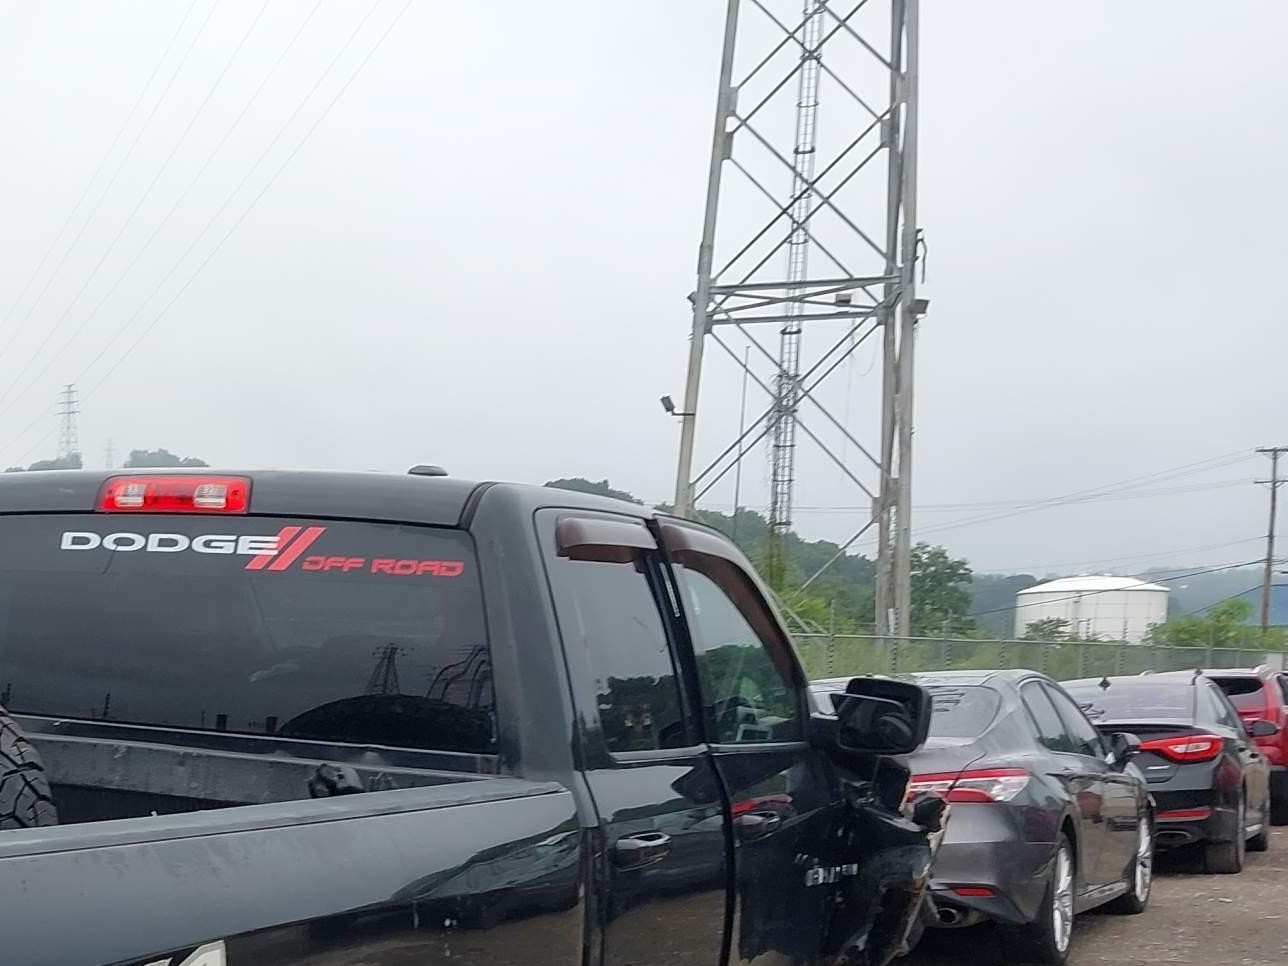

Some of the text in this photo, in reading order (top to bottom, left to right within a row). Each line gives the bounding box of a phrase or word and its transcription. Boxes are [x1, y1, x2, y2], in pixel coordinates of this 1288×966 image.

[60, 531, 282, 556] DODGE
[302, 556, 464, 577] OFF ROAD
